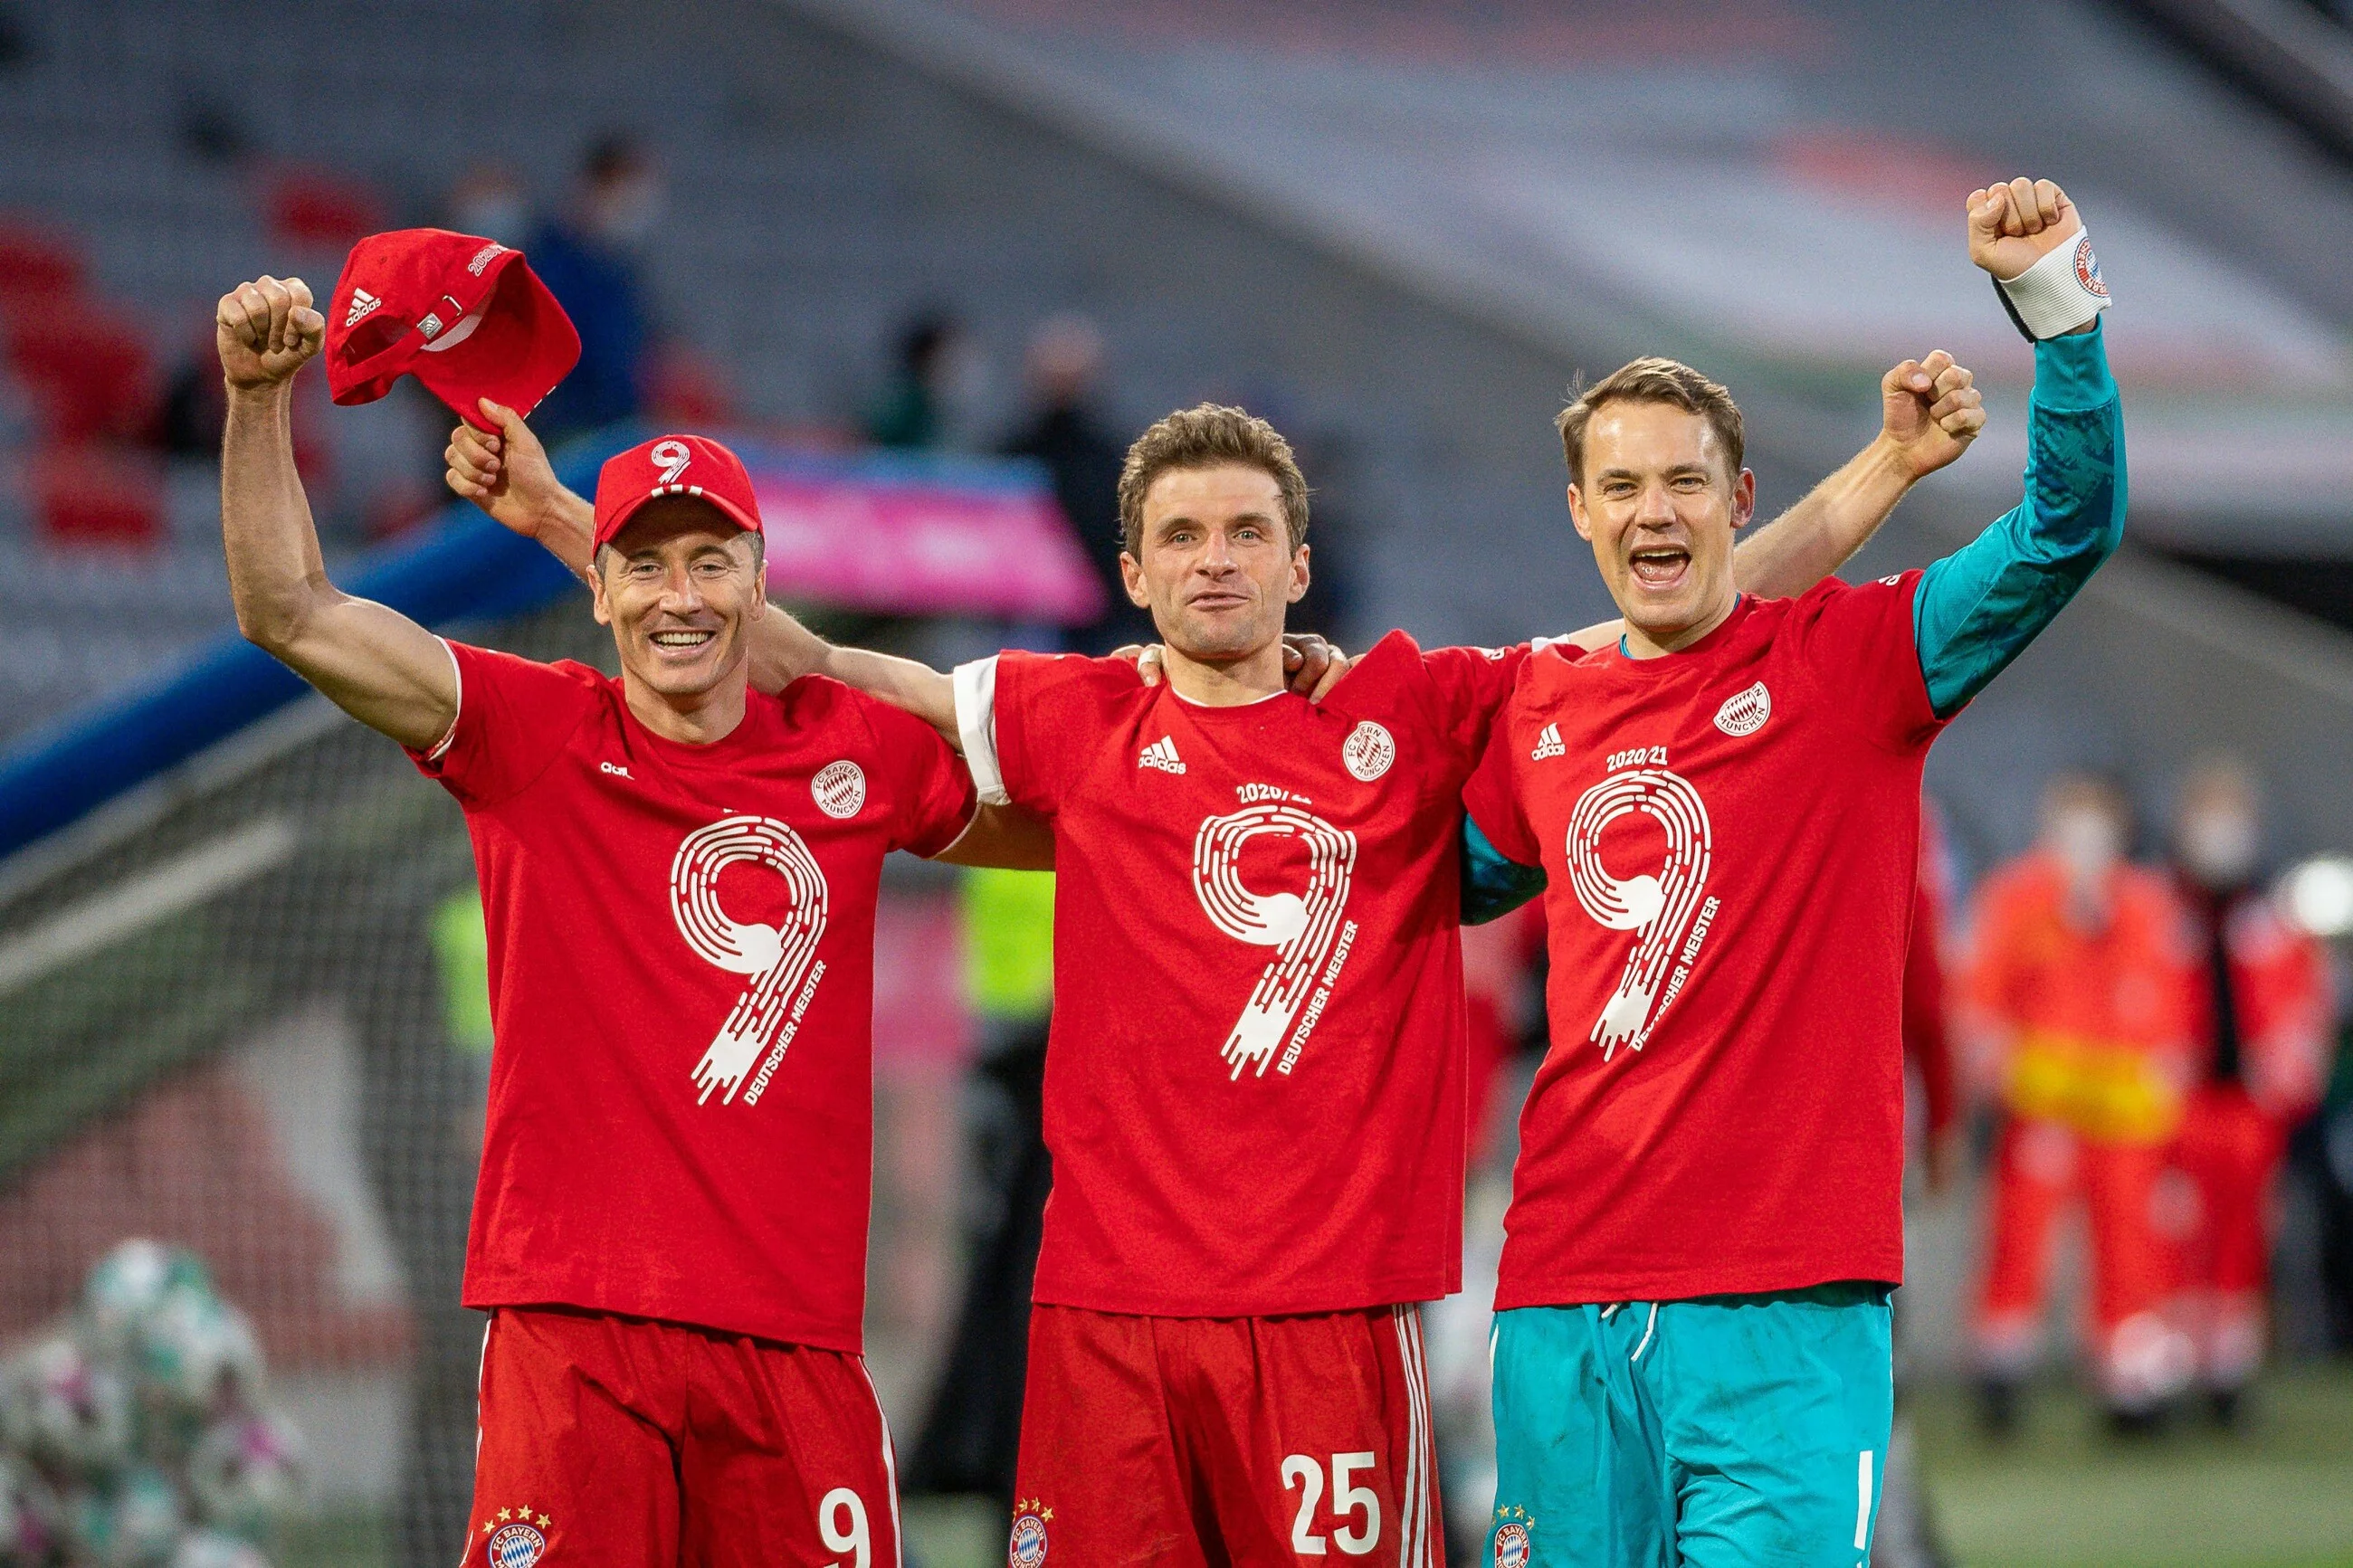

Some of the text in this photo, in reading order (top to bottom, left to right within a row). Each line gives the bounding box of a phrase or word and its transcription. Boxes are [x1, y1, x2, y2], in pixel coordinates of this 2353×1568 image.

[346, 297, 382, 328] adidas
[651, 441, 691, 484] 9
[1138, 754, 1186, 774] adidas
[1348, 744, 1357, 756] FC
[1531, 743, 1567, 761] adidas
[1606, 746, 1668, 773] 2020/21
[815, 765, 859, 789] FC BAYERN
[1566, 769, 1712, 1062] 9
[1680, 895, 1721, 965] MEISTER
[671, 815, 829, 1106] 9
[1193, 805, 1358, 1081] 9
[1277, 919, 1358, 1075] DEUTSCHER MEISTER
[744, 959, 827, 1107] DEUTSCHER MEISTER
[1281, 1451, 1381, 1554] 25
[493, 1527, 541, 1551] FC BAYERN
[819, 1487, 871, 1568] 9
[1014, 1520, 1044, 1543] FC BAYERN
[1497, 1525, 1529, 1548] FC BAYERN
